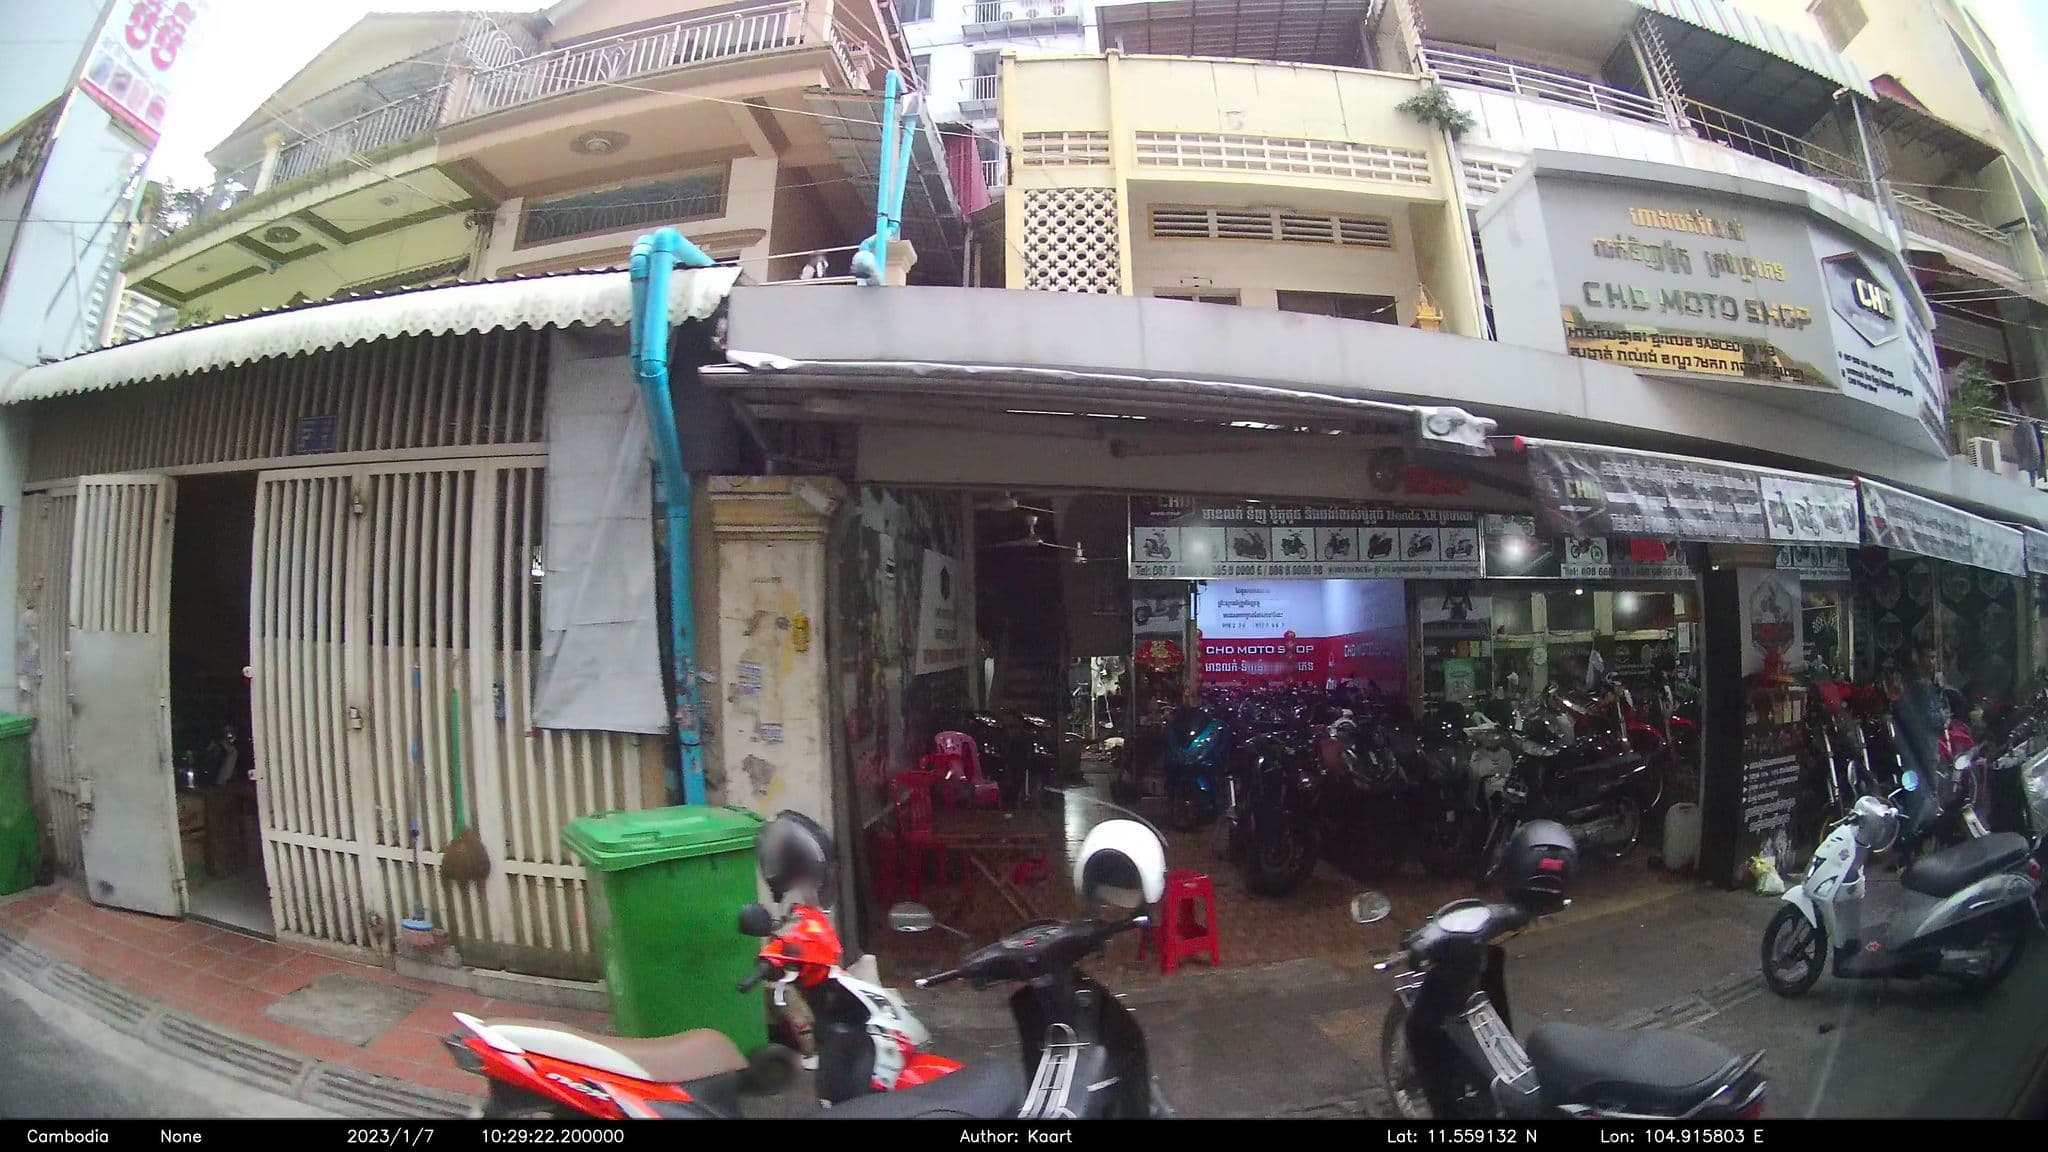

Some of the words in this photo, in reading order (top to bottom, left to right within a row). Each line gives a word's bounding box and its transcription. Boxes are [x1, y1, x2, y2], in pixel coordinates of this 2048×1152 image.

[1582, 281, 1650, 311] CHO
[1660, 287, 1738, 321] MOTO
[1745, 298, 1813, 331] SHOP
[1206, 646, 1234, 654] CHO
[1237, 645, 1274, 654] MOTO
[1277, 645, 1314, 654] SOP
